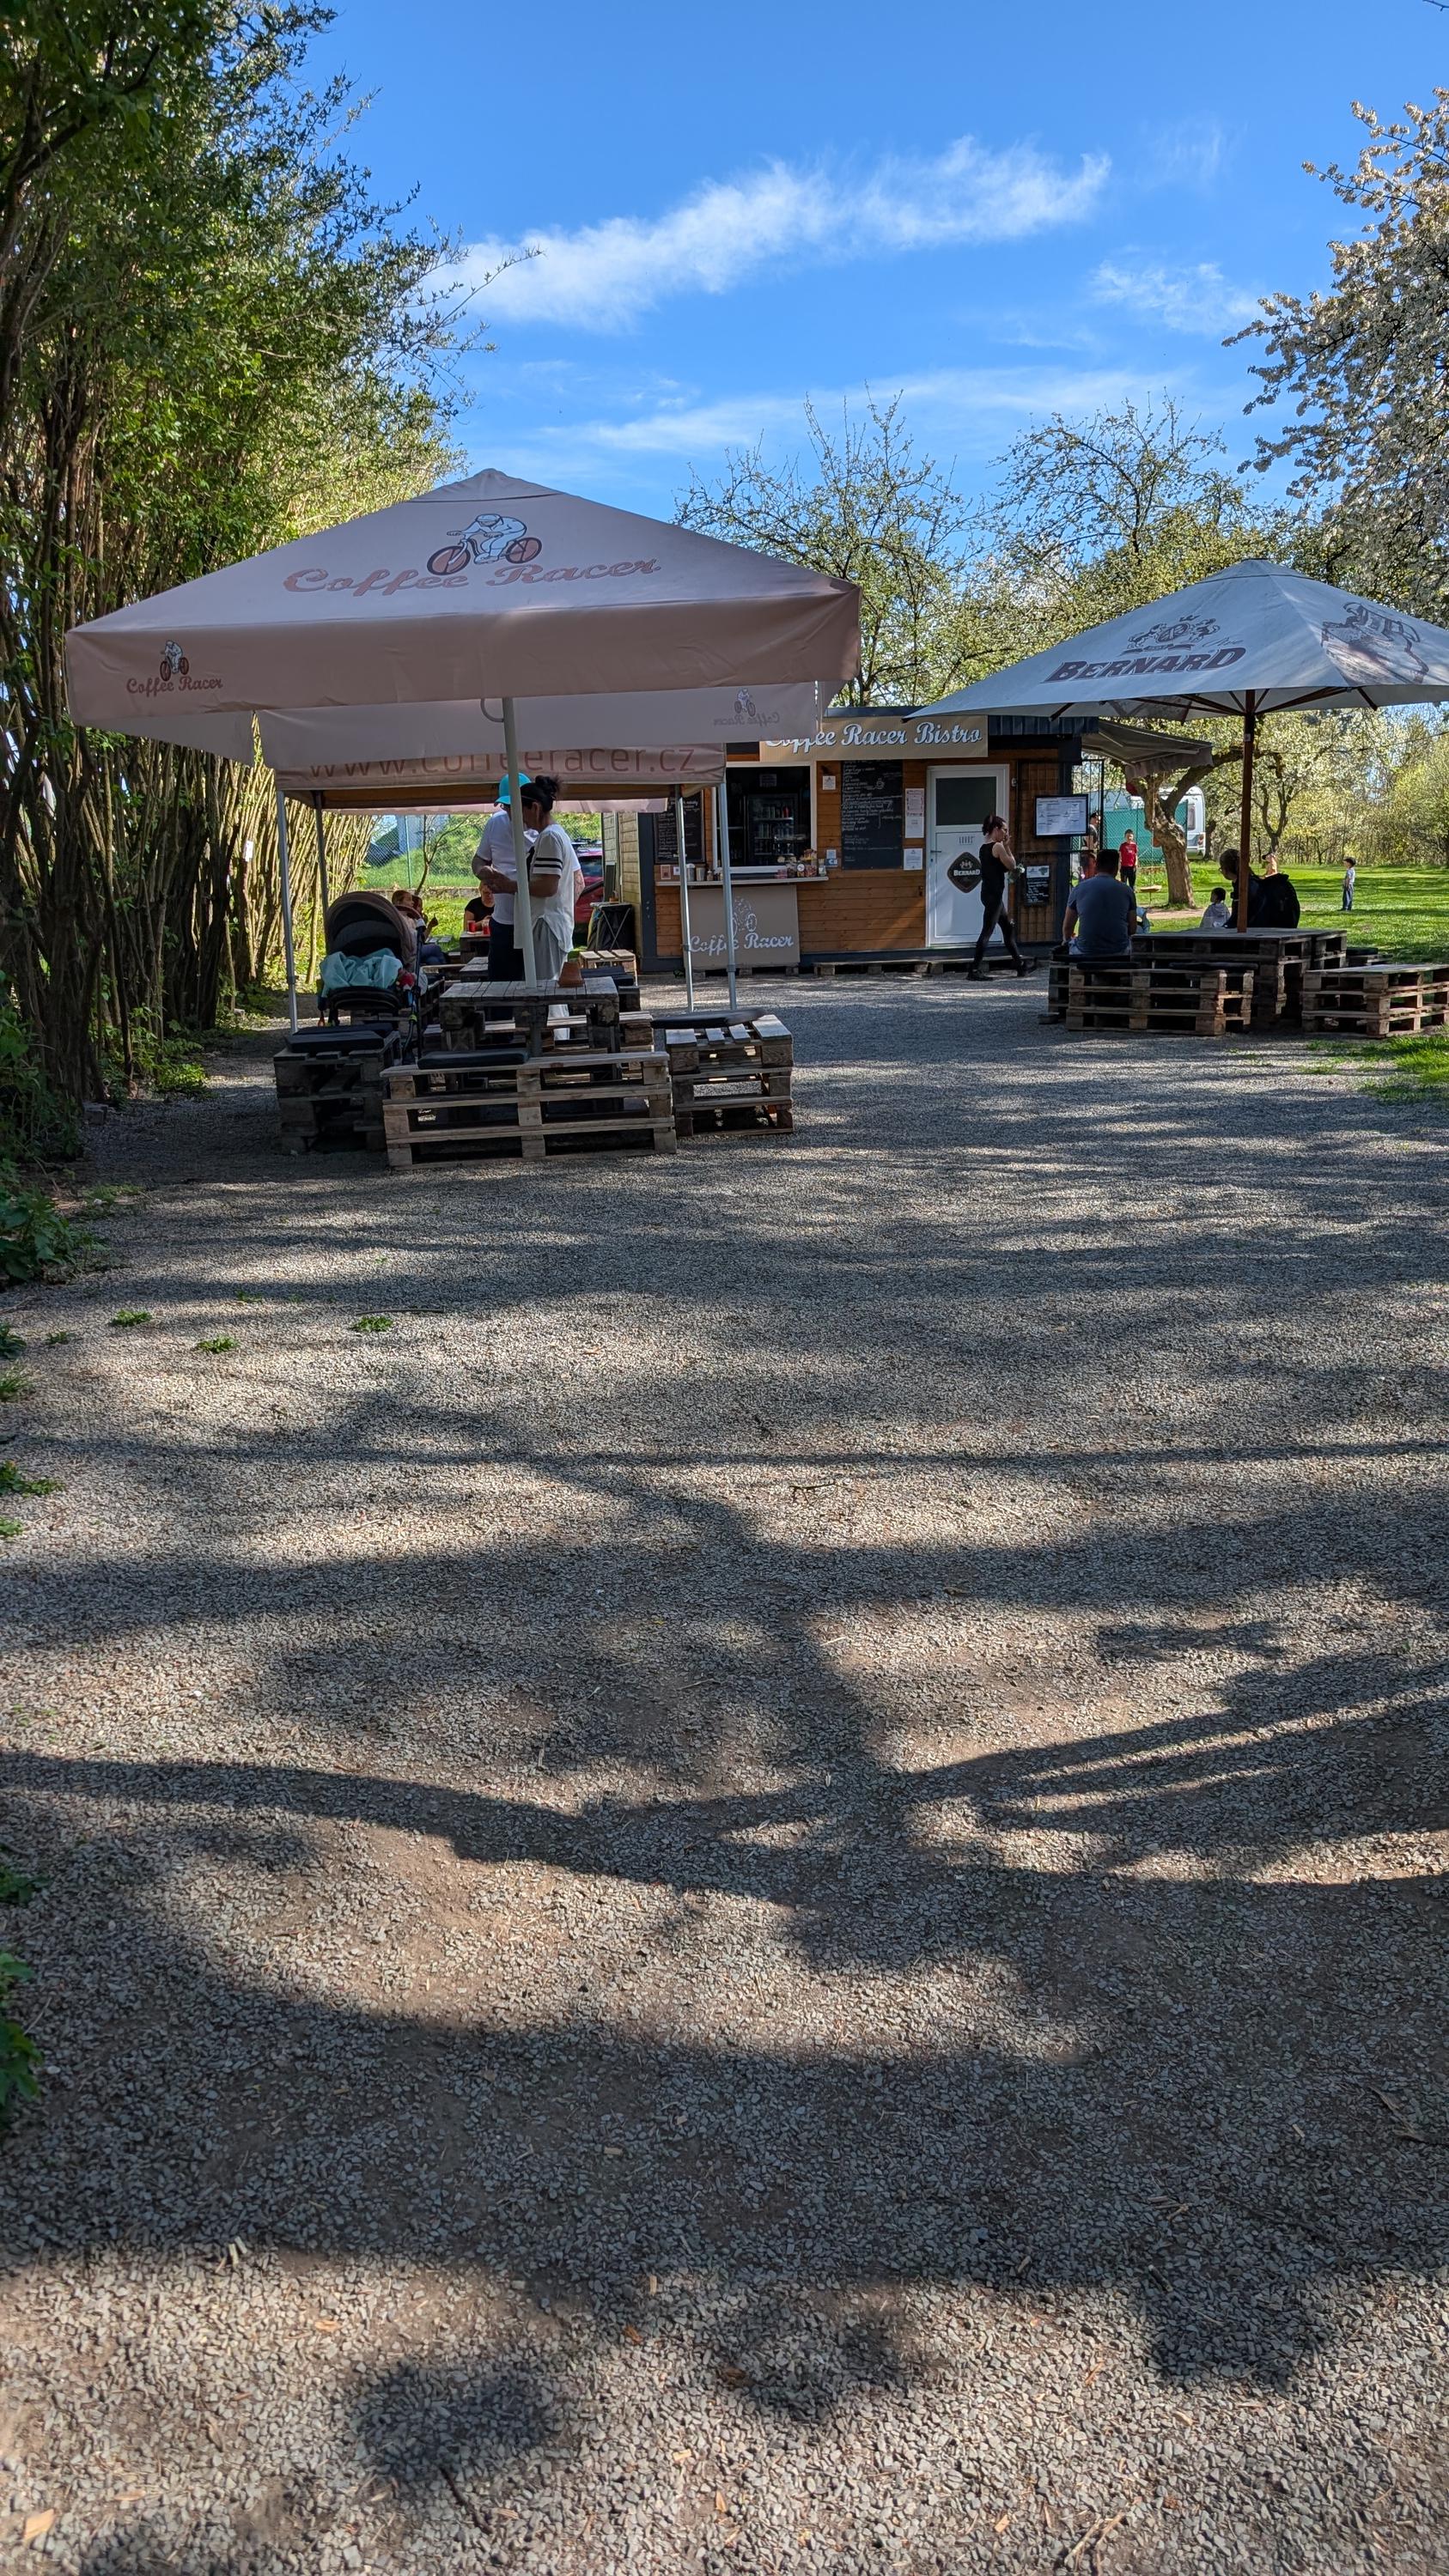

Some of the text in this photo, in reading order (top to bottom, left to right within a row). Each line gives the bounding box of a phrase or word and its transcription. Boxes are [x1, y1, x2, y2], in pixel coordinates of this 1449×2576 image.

[282, 556, 662, 598] Coffee Racer
[1038, 647, 1246, 684] BERNARD
[126, 676, 223, 697] Coffee Racer
[842, 723, 908, 746] Racer
[914, 721, 983, 744] Bistro
[744, 932, 795, 950] Racer
